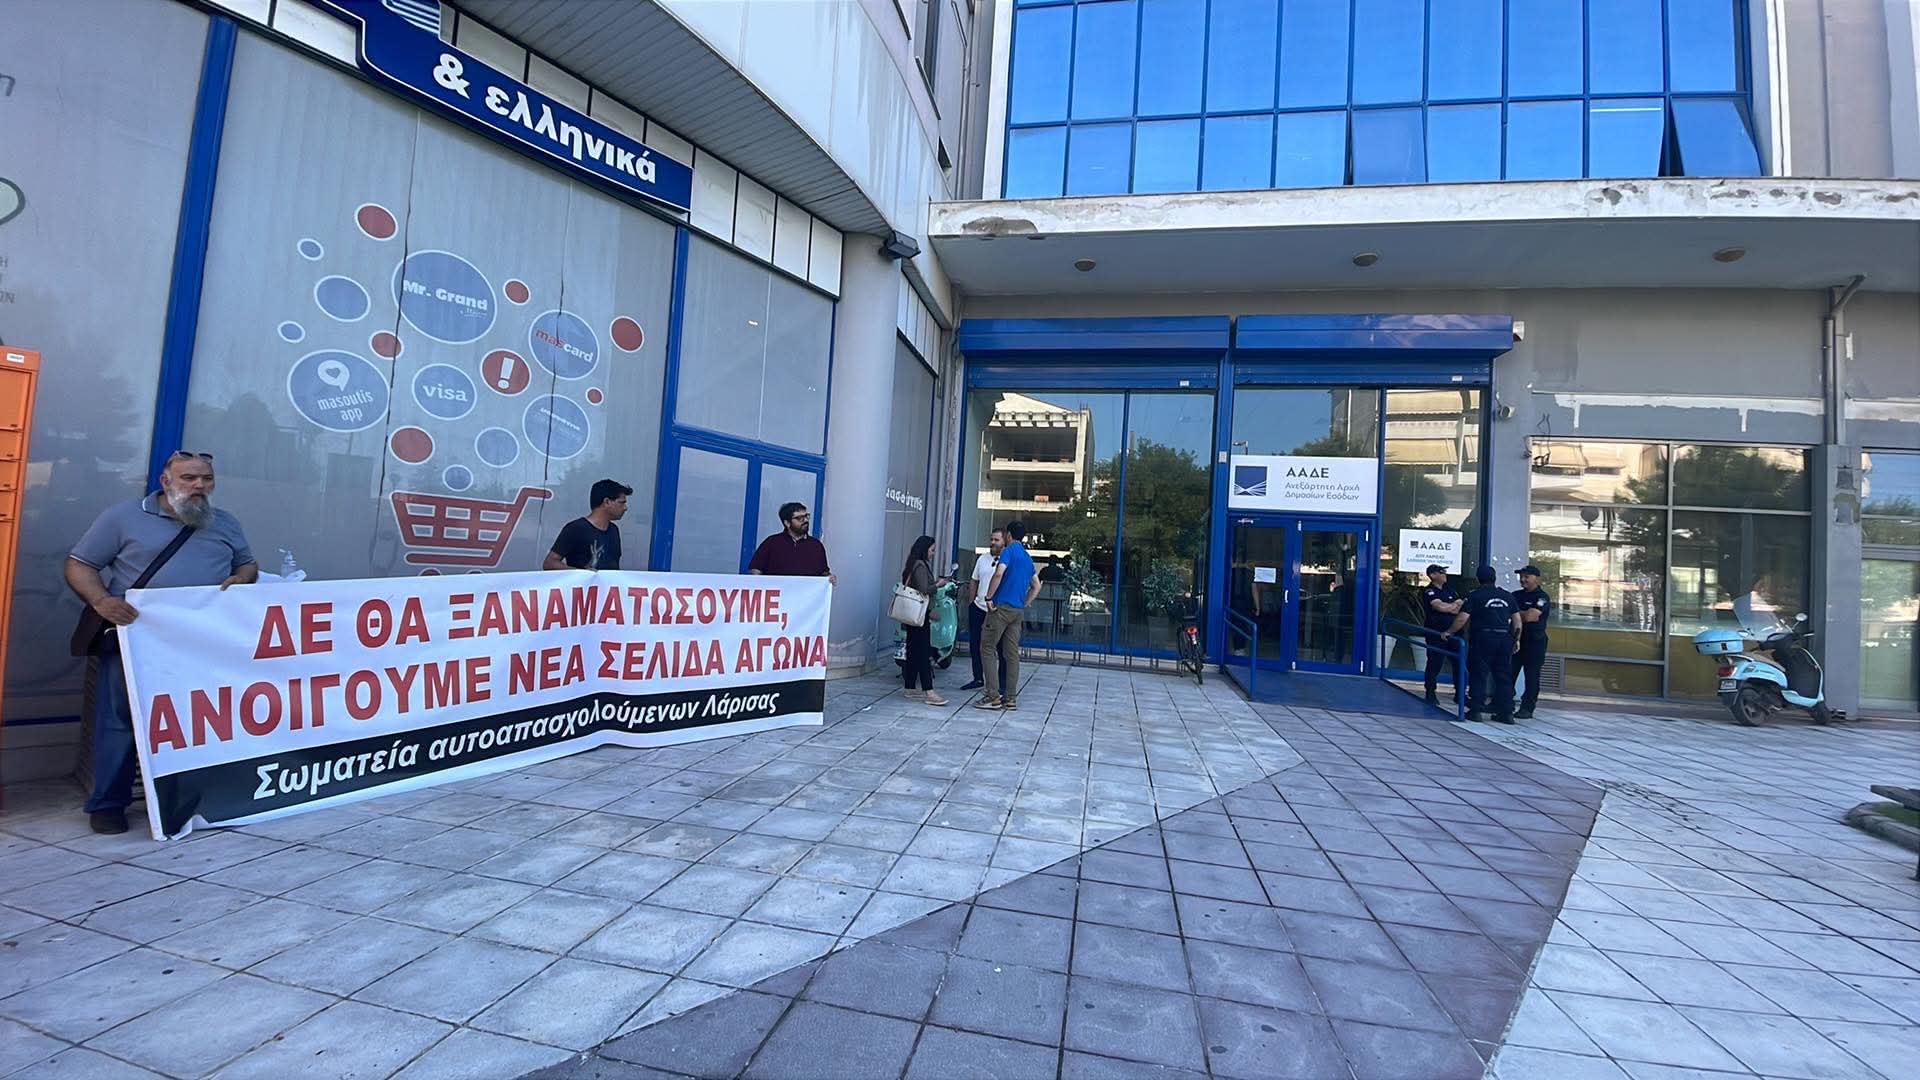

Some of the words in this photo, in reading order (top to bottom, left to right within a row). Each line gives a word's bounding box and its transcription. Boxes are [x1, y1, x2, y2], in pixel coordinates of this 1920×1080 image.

[433, 53, 470, 99] &
[485, 85, 655, 184] ελληνικά
[403, 280, 431, 297] Mr.
[435, 288, 488, 310] Grand
[535, 329, 594, 363] mascard
[317, 389, 374, 411] masoutis
[423, 383, 468, 402] visa
[340, 408, 363, 423] app
[1286, 467, 1329, 478] ΑΑΔΕ
[1420, 541, 1452, 551] ΑΑΔΕ
[253, 602, 333, 660] ΔΕ
[356, 597, 430, 648] ΘΑ
[449, 585, 788, 640] ΞΑΝΑΜΑΤΩΣΟΥΜΕ,
[149, 656, 491, 755] ΑΝΟΙΓΟΥΜΕ
[509, 644, 585, 696] ΝΕΑ
[597, 639, 725, 680] ΣΕΛΙΔΑ
[734, 635, 827, 674] ΑΓΩΝΑ
[253, 738, 419, 800] Σωματεία
[429, 700, 700, 760] αυτοαπασχολούμενων
[702, 690, 780, 718] Λάρισας
